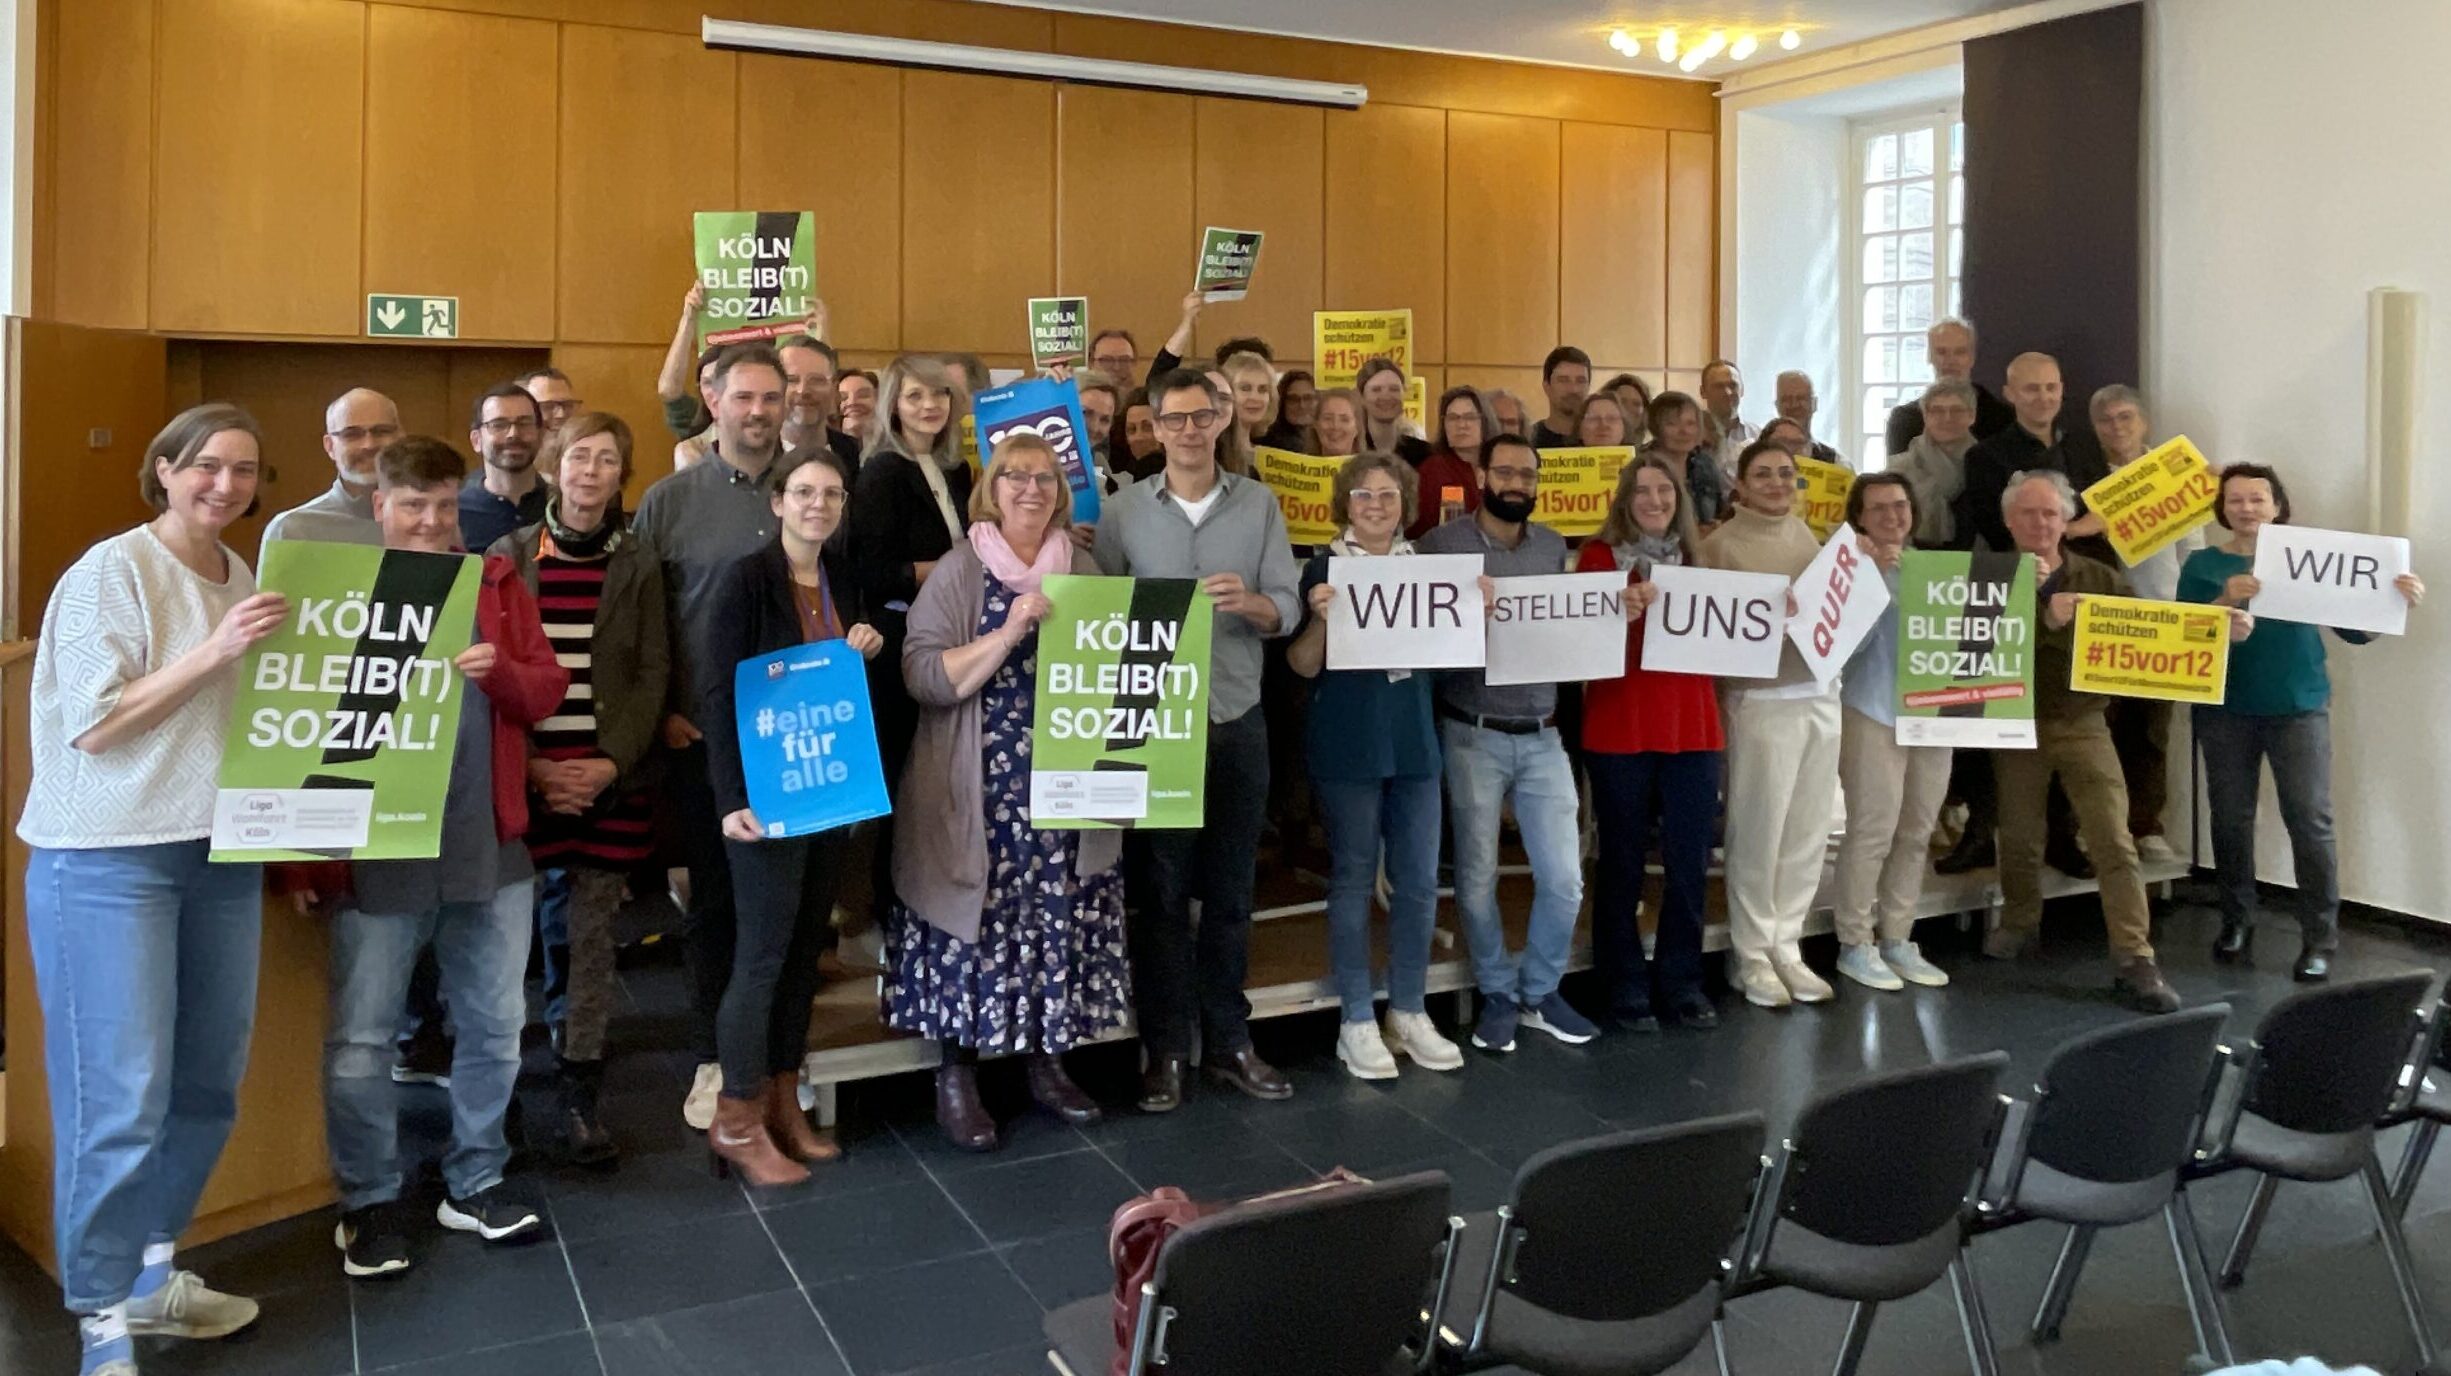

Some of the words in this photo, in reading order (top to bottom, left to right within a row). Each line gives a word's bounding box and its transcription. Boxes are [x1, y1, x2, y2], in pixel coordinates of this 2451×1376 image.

[718, 232, 791, 259] KÖLN
[703, 265, 808, 290] BLEIB(T)
[707, 296, 806, 318] SOZIAL!
[1041, 310, 1076, 323] KÖLN
[1324, 319, 1386, 330] Demokratie
[1265, 455, 1338, 478] Demokratie
[2092, 462, 2160, 504] Demokratie
[2102, 483, 2155, 517] schützen
[2114, 473, 2216, 541] #15vor12
[2285, 547, 2379, 590] WIR
[1347, 581, 1463, 629] WIR
[1494, 590, 1620, 623] STELLEN
[1813, 544, 1858, 658] QUER
[1926, 575, 2008, 606] KÖLN
[296, 590, 433, 642] KÖLN
[1662, 592, 1773, 643] UNS
[1908, 615, 2026, 645] BLEIB(T)
[2088, 622, 2158, 639] schützen
[2090, 603, 2179, 625] Demokratie
[1075, 612, 1177, 651] KÖLN
[1908, 651, 2022, 676] SOZIAL!
[2086, 641, 2214, 677] #15vor12
[254, 652, 451, 703] BLEIB(T)
[1048, 661, 1199, 700] BLEIB(T)
[248, 708, 440, 751] SOZIAL!
[756, 700, 855, 738] #eine
[1049, 706, 1193, 739] SOZIAL!
[782, 728, 836, 762] für
[781, 757, 848, 793] alle
